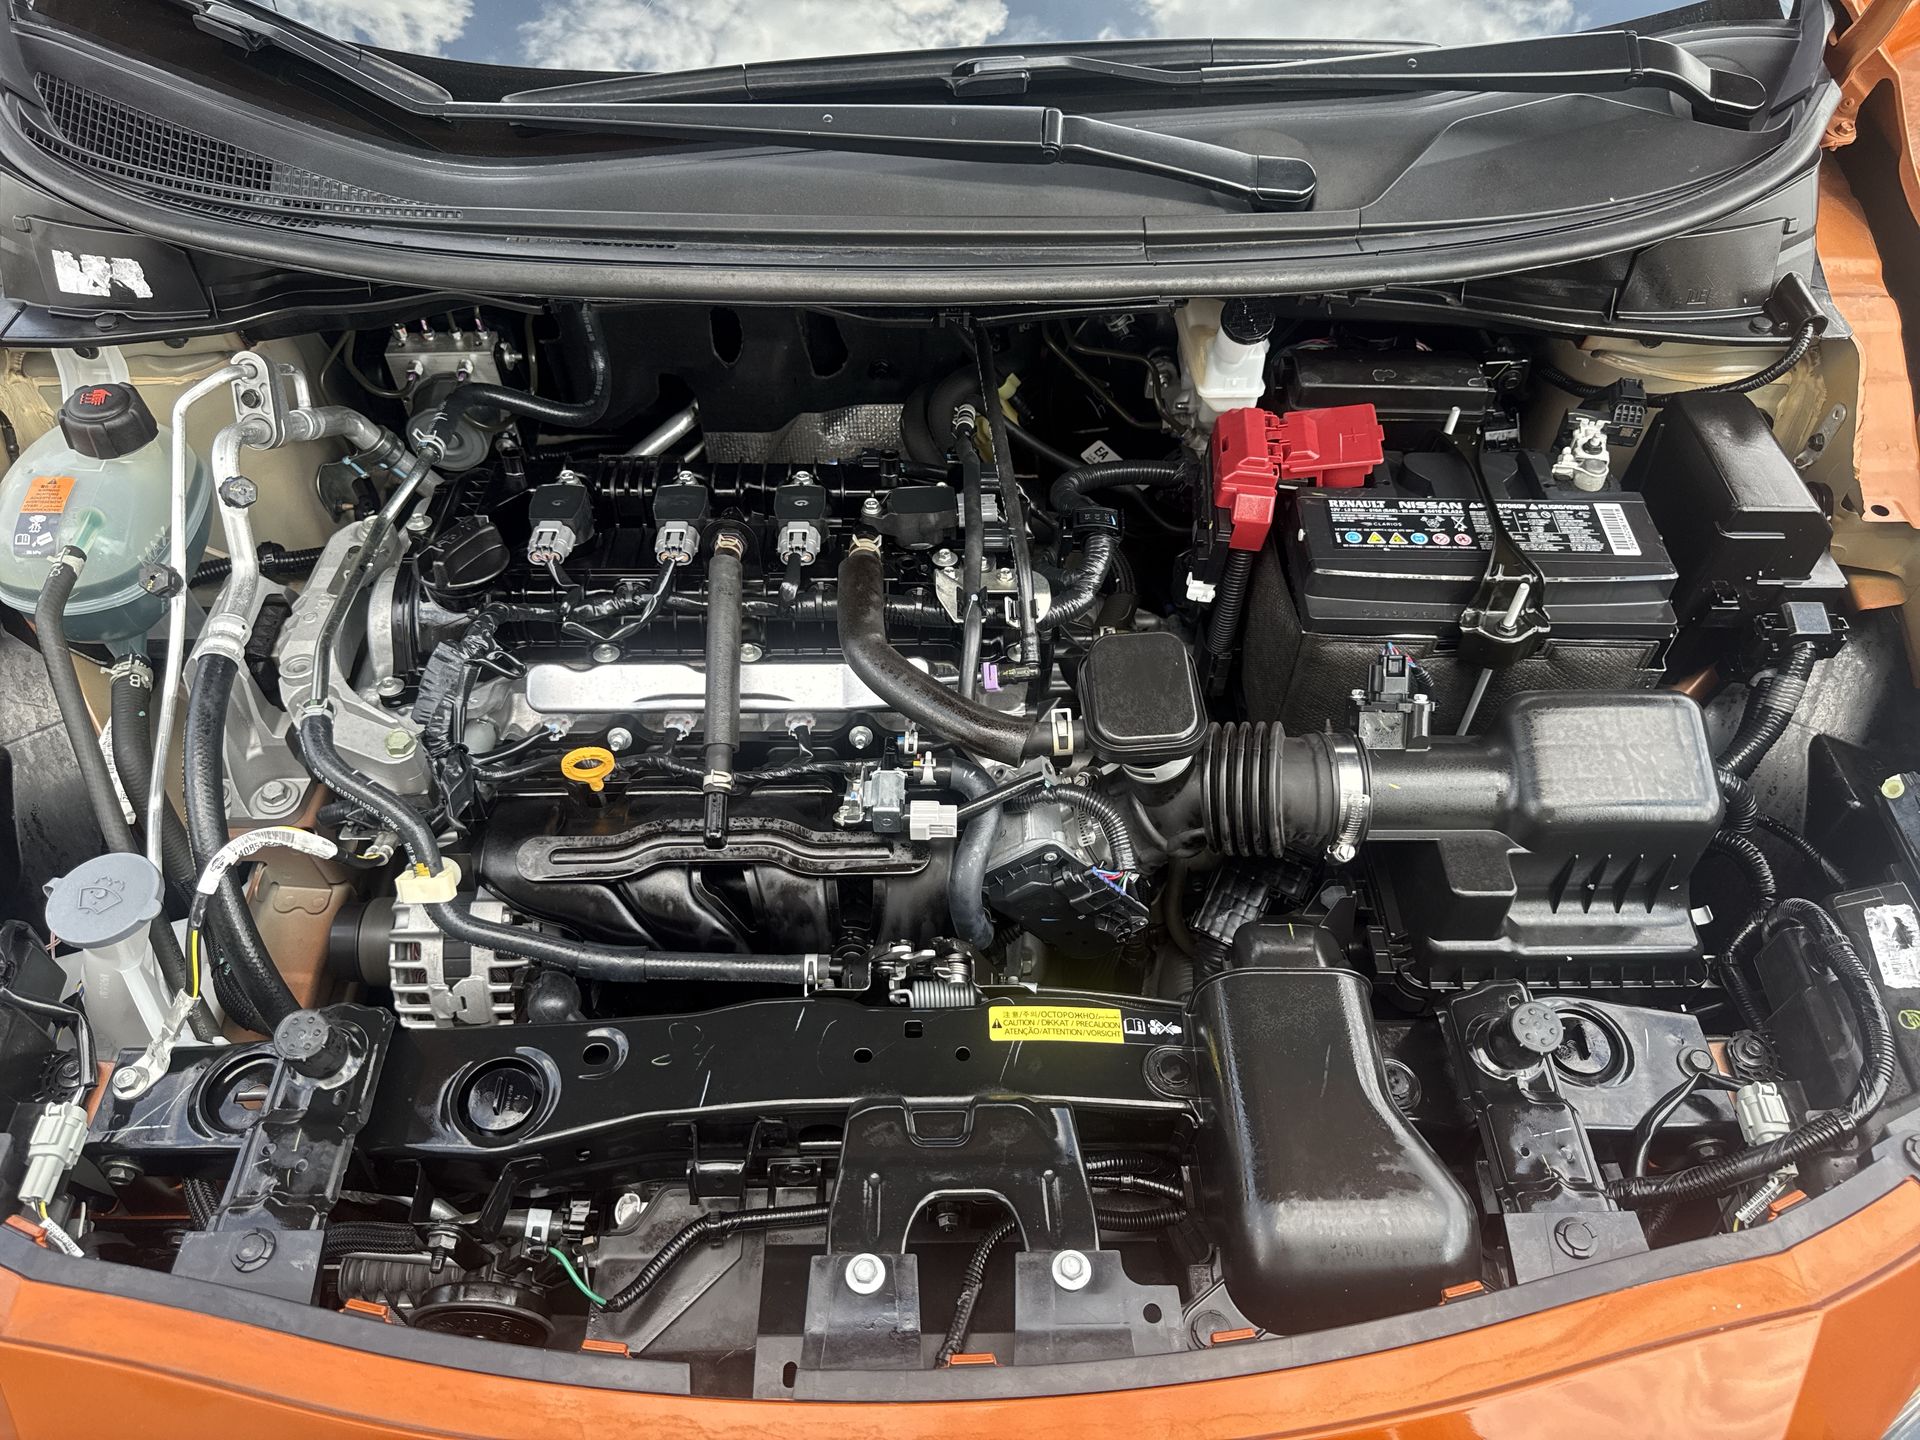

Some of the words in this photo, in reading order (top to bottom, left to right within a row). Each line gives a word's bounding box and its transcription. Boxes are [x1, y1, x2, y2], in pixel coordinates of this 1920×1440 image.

[1328, 500, 1386, 509] RENAULT
[1398, 501, 1463, 510] NISSAN
[1003, 1019, 1035, 1027] CAUTION
[1041, 1019, 1069, 1027] DIKKAT
